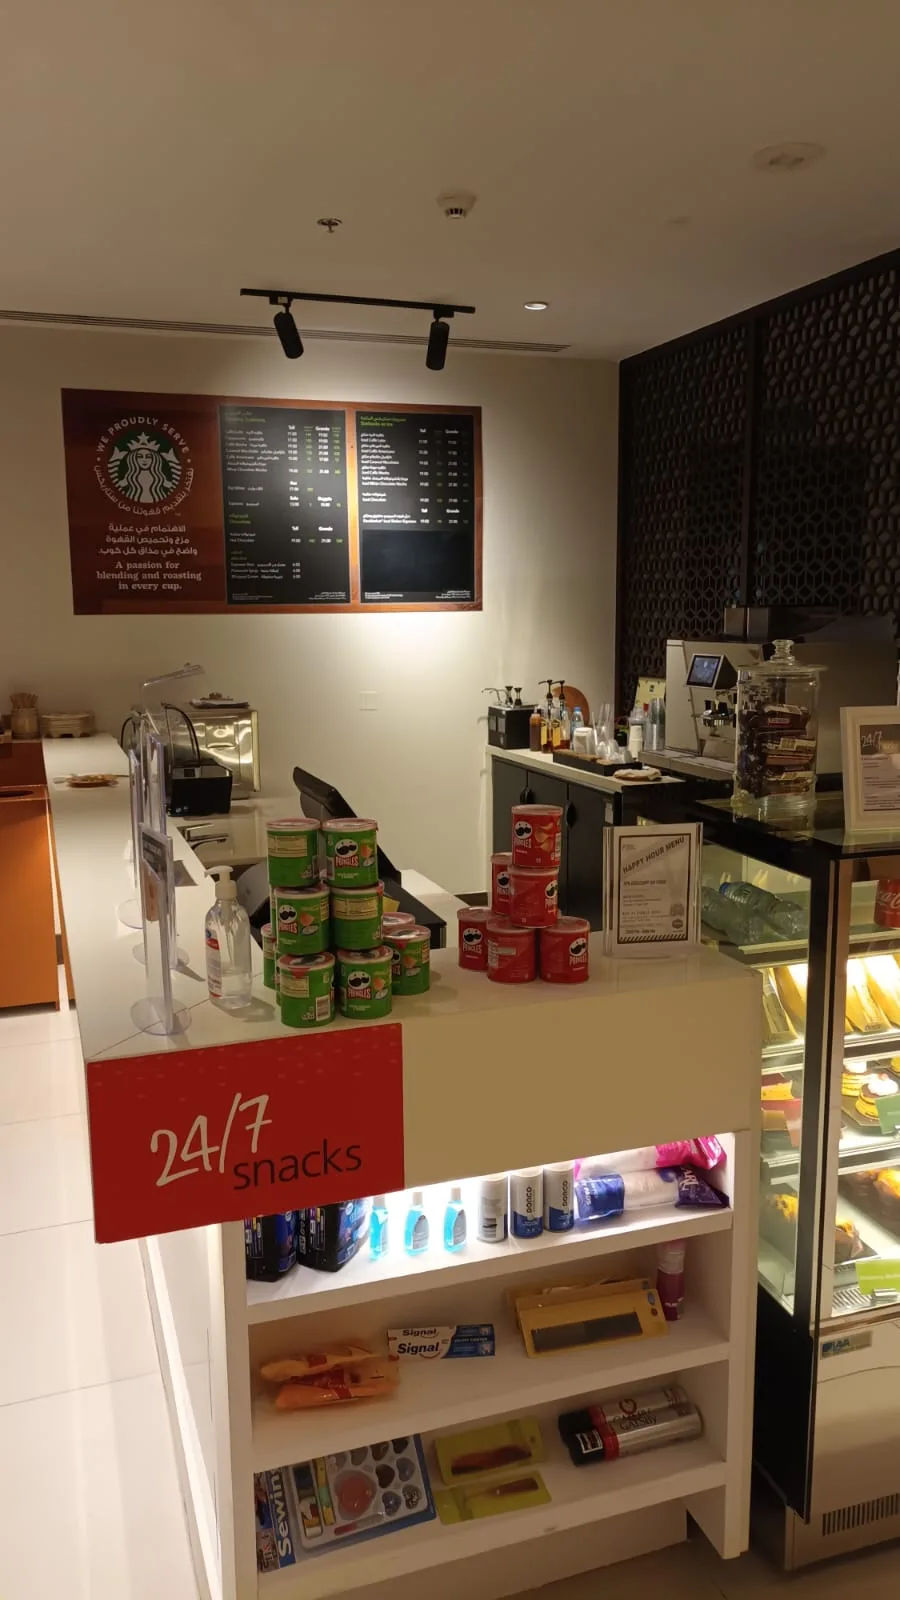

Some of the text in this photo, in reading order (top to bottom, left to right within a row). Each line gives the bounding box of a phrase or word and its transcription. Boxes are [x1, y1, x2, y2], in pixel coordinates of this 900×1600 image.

[97, 416, 190, 454] WE PROUDLY SERVE
[109, 523, 186, 534] الاهتمام في عملية
[105, 534, 190, 544] مزج وتحميص القهوة
[122, 546, 137, 555] كل
[138, 546, 159, 555] مذاق
[161, 547, 174, 557] في
[175, 546, 198, 556] واضح
[115, 561, 181, 570] A passion for
[96, 571, 202, 581] blending and roasting
[118, 581, 183, 591] in every cup.
[623, 836, 686, 873] HAPPY HOUR MENU
[335, 855, 359, 868] PRINGLES
[150, 1093, 272, 1187] 24/7
[233, 1139, 362, 1190] snacks
[402, 1328, 437, 1337] Signal
[397, 1342, 440, 1355] Signal
